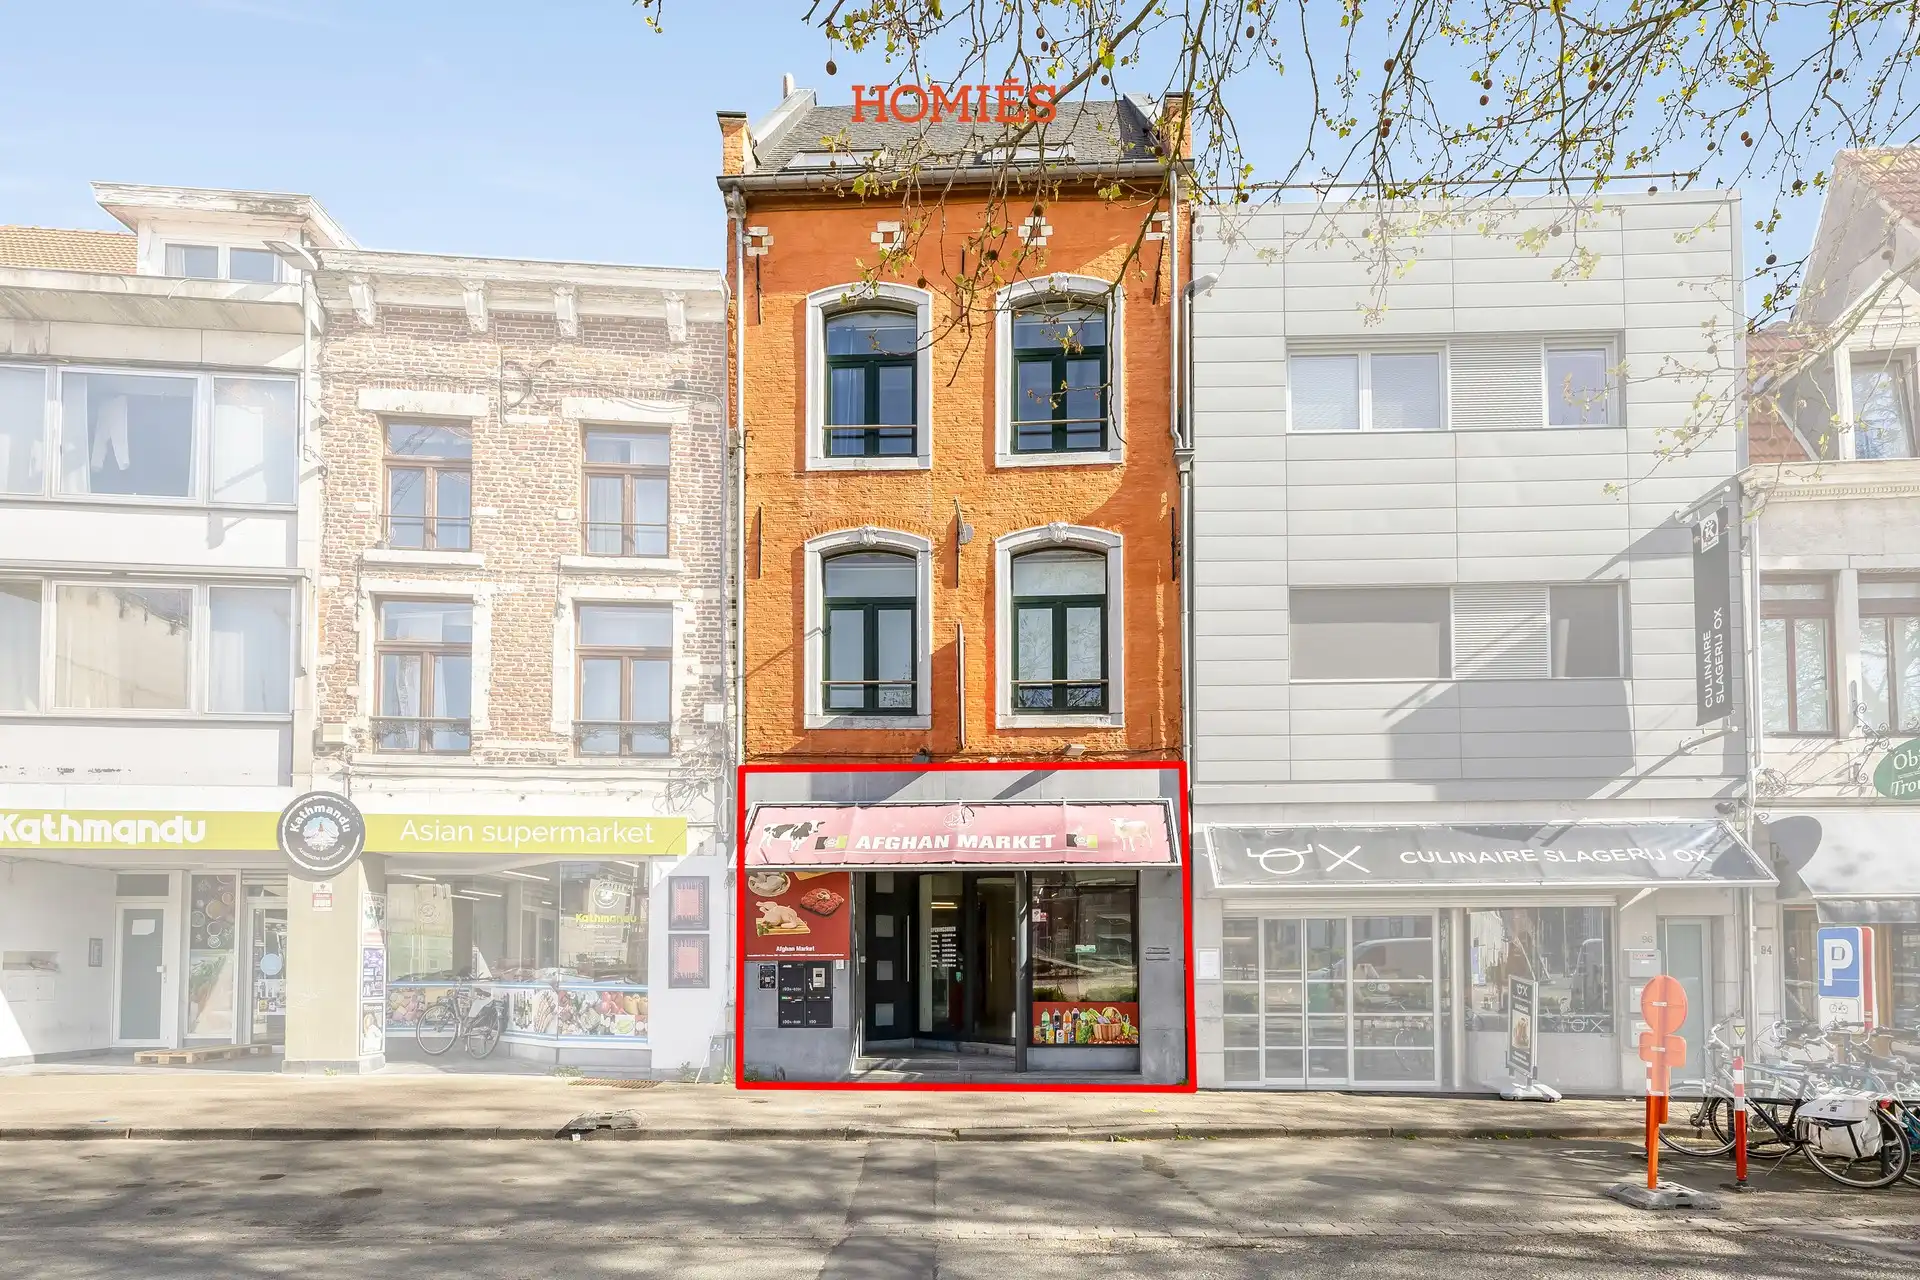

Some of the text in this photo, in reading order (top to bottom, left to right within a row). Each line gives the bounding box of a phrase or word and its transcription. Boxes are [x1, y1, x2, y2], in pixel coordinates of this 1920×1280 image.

[1703, 629, 1713, 708] CULINAIRE
[1713, 606, 1725, 704] SLAGERIJ OX
[0, 813, 206, 845] Kathmandu
[289, 804, 351, 833] Kathmandu
[400, 819, 656, 849] Asian supermarket
[855, 834, 1057, 850] AFGHAN MARKET
[1400, 848, 1714, 865] CULINAIRE SLAGERIJ OX
[776, 945, 796, 953] Afghan
[1823, 938, 1854, 987] P
